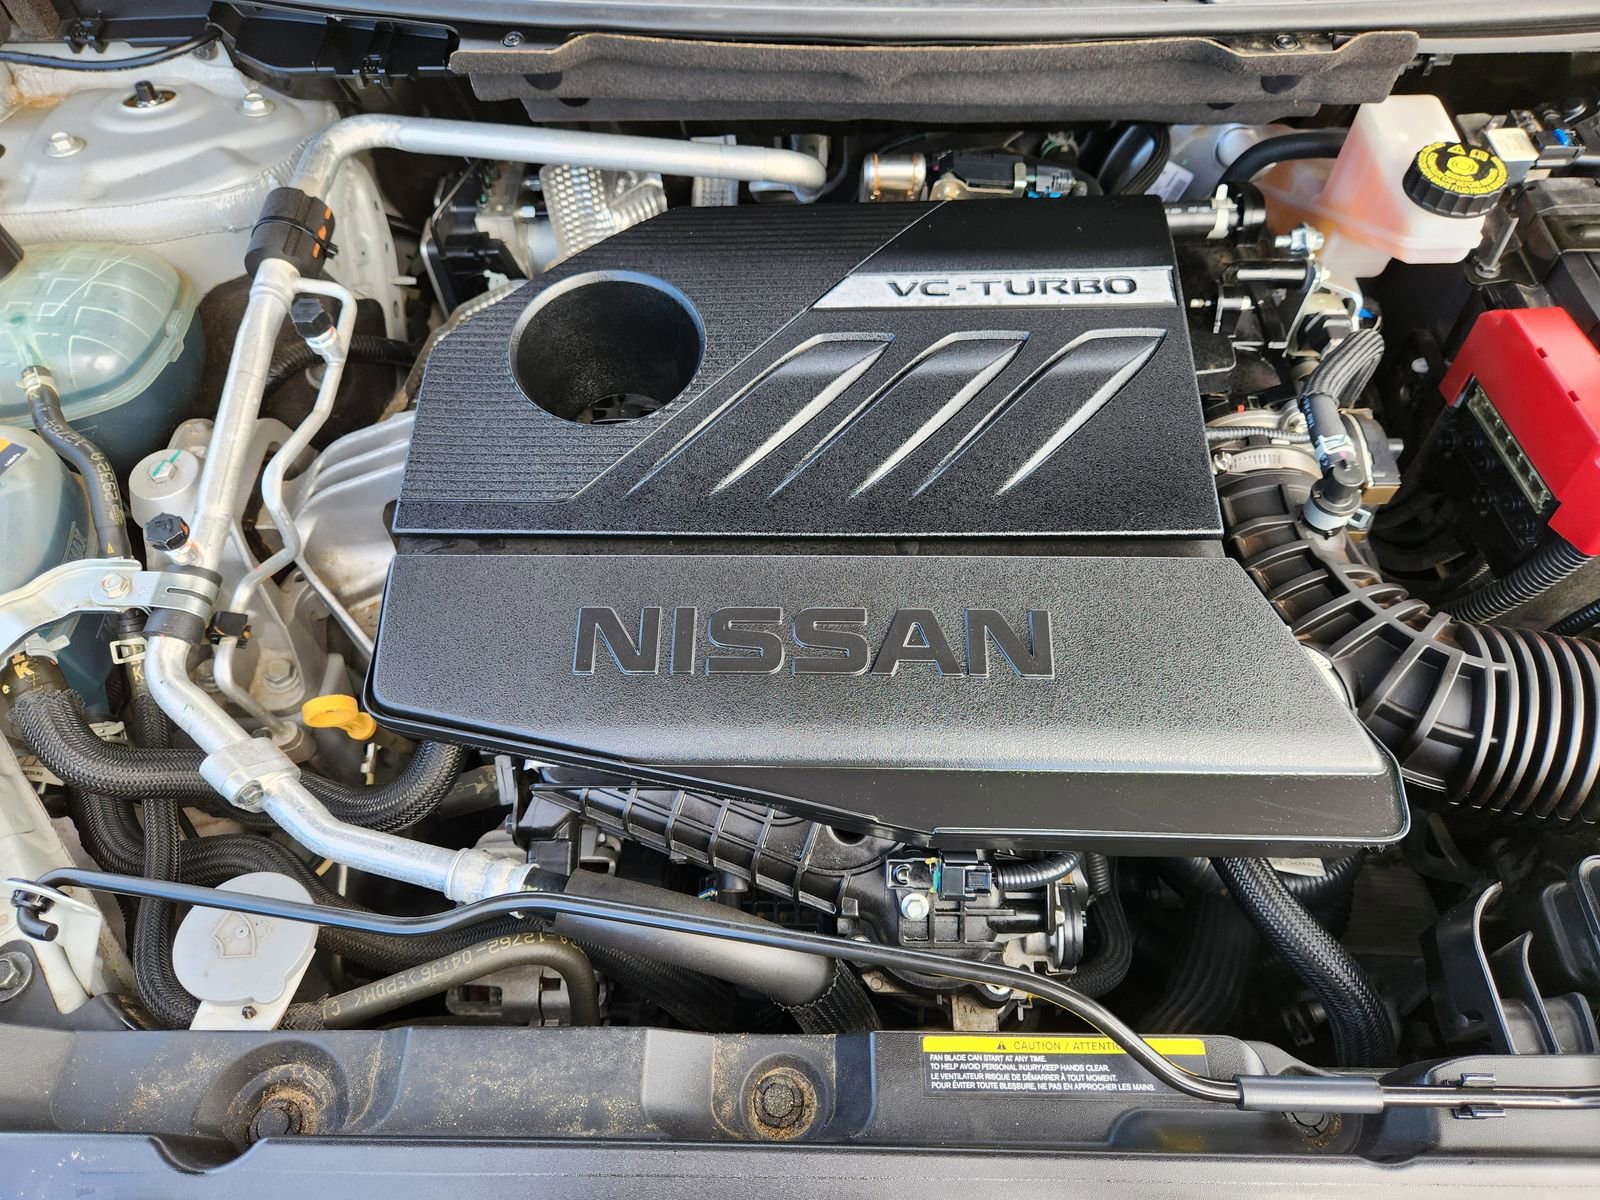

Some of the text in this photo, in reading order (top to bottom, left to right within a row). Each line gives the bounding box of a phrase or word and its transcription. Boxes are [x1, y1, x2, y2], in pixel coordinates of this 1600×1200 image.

[887, 275, 1137, 297] VC-TURBO
[572, 606, 1056, 680] NISSAN
[1013, 1041, 1061, 1051] CAUTION
[1073, 1042, 1122, 1051] ATTENTIO
[930, 1053, 943, 1061] FAN
[944, 1054, 967, 1062] BLADE
[967, 1054, 982, 1062] CAN
[930, 1062, 940, 1070] TO
[940, 1062, 959, 1070] HELP
[960, 1063, 981, 1071] AVOID
[982, 1063, 1018, 1071] PERSONAL
[1060, 1064, 1085, 1072] HANDS
[1085, 1064, 1111, 1072] CLEAR.
[940, 1073, 985, 1081] VENTILATEUR
[984, 1073, 1010, 1081] RISQUE
[1022, 1072, 1060, 1081] DÉMARRER
[1066, 1074, 1085, 1082] TOUT
[1085, 1074, 1119, 1082] MOMENT.
[931, 1080, 1157, 1092] POUR ÉVITER TOUTE BLESSURE, NE PAS EN APPROCHER LES MAINS.
